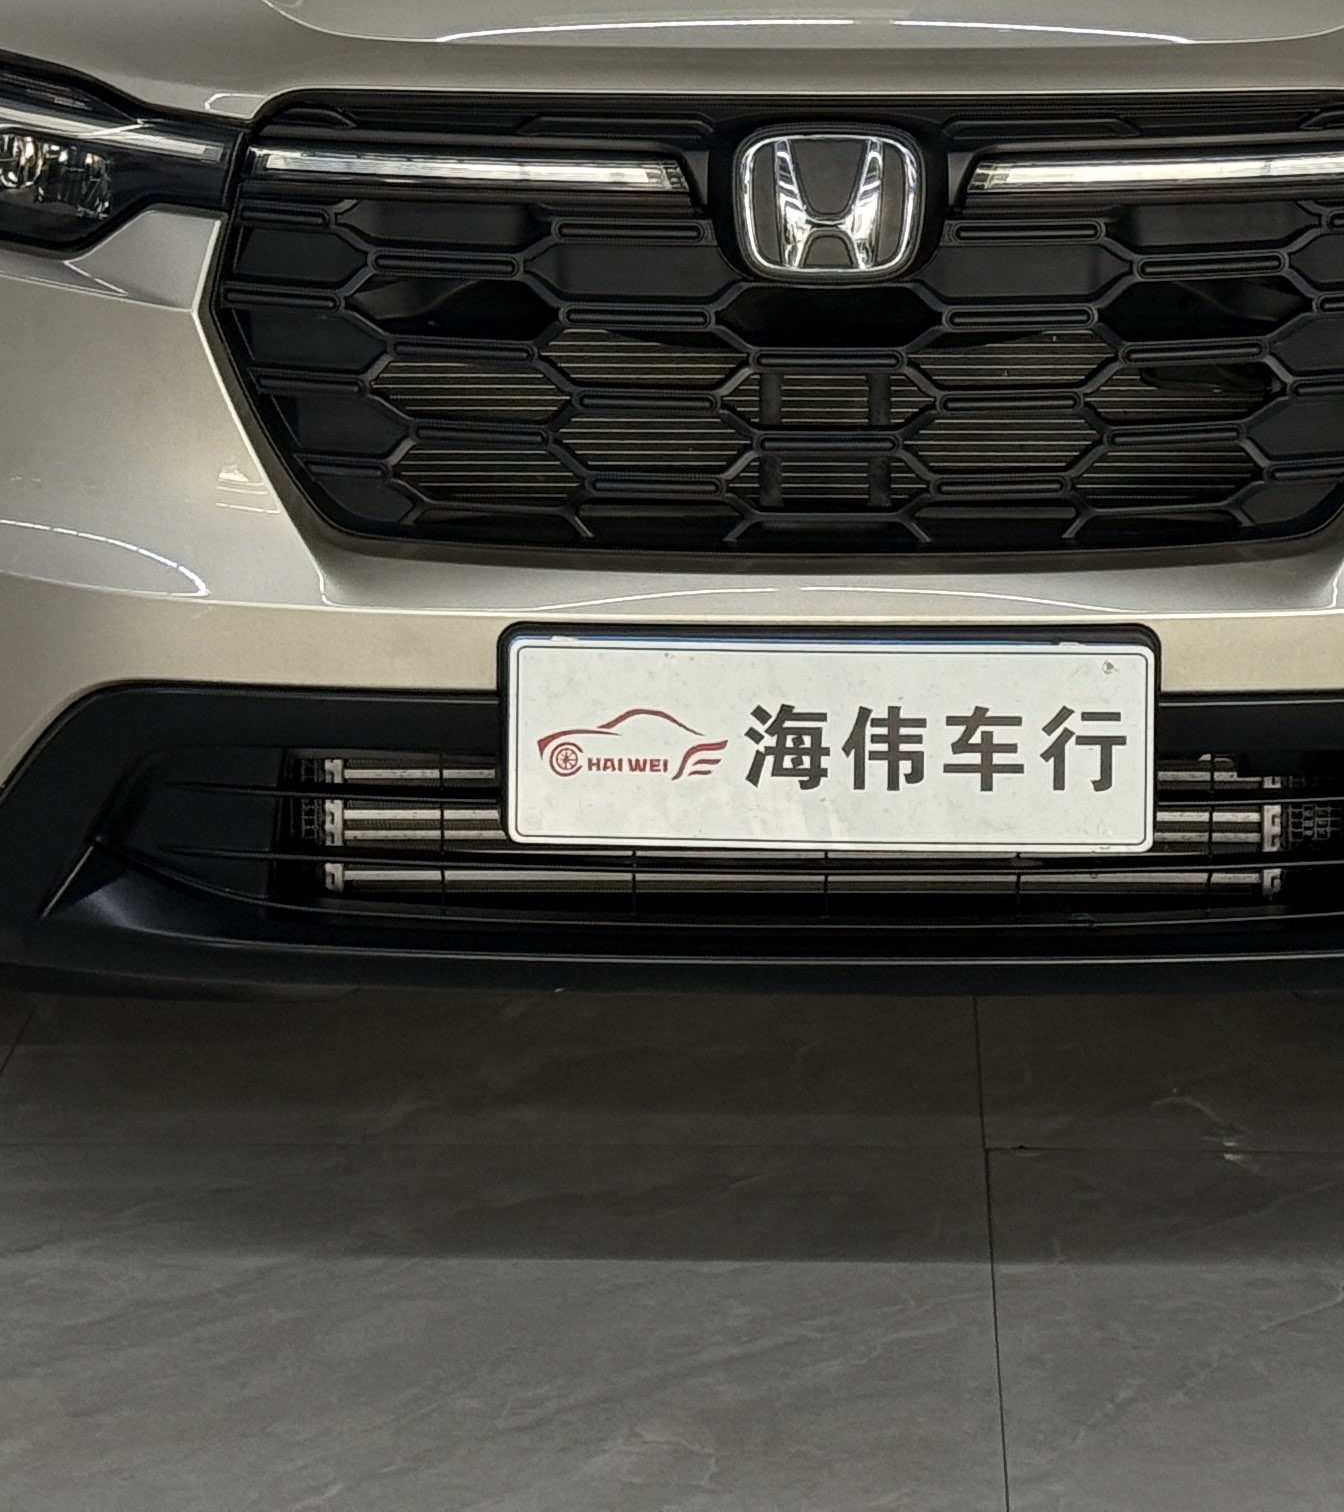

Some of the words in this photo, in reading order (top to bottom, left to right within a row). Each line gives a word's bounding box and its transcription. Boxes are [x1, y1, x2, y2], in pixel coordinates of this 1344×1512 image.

[587, 757, 623, 772] HAI
[627, 757, 669, 773] WEI
[743, 703, 1128, 793] 海伟车行
